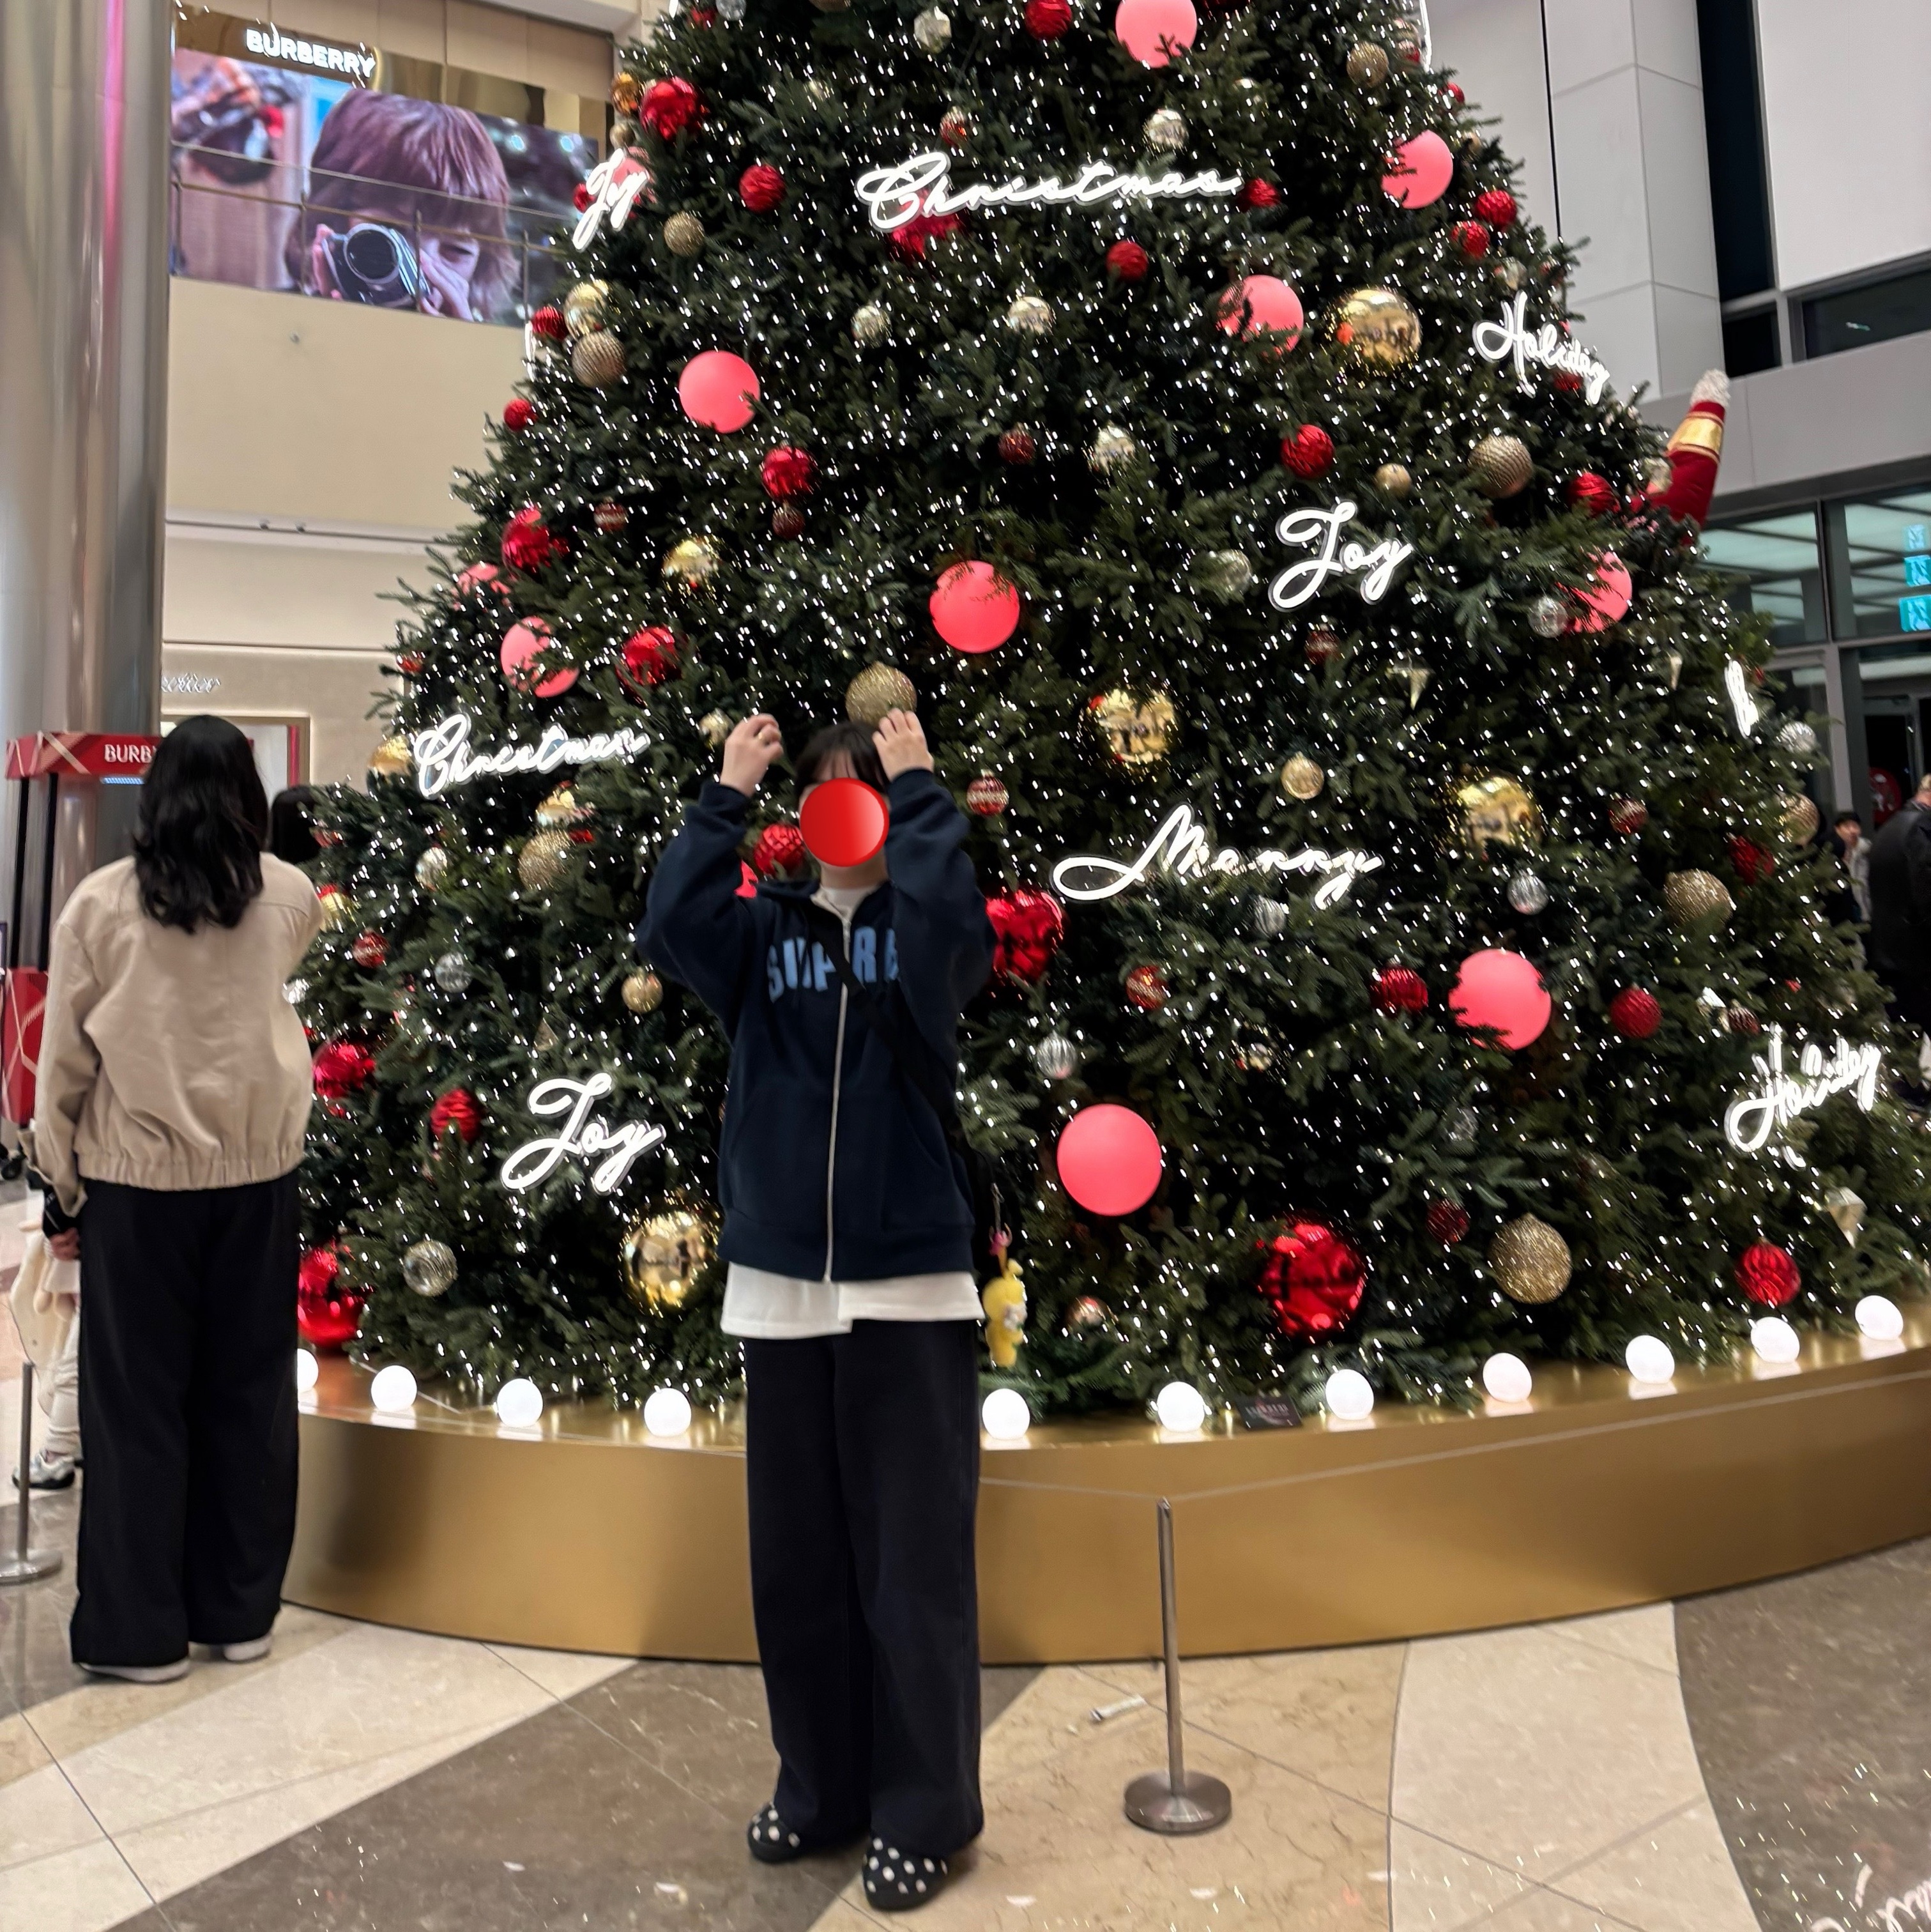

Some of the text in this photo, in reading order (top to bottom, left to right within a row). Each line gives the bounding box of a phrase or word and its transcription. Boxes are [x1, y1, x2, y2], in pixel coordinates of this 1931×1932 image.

[246, 28, 376, 78] BURBERRY
[857, 151, 1243, 232] Christmas
[1472, 290, 1610, 406] Holiday
[1269, 500, 1413, 611] Joy
[104, 744, 157, 763] BURB
[414, 712, 650, 799] Christmas
[1053, 803, 1384, 910] Merry
[501, 1072, 667, 1195] Joy
